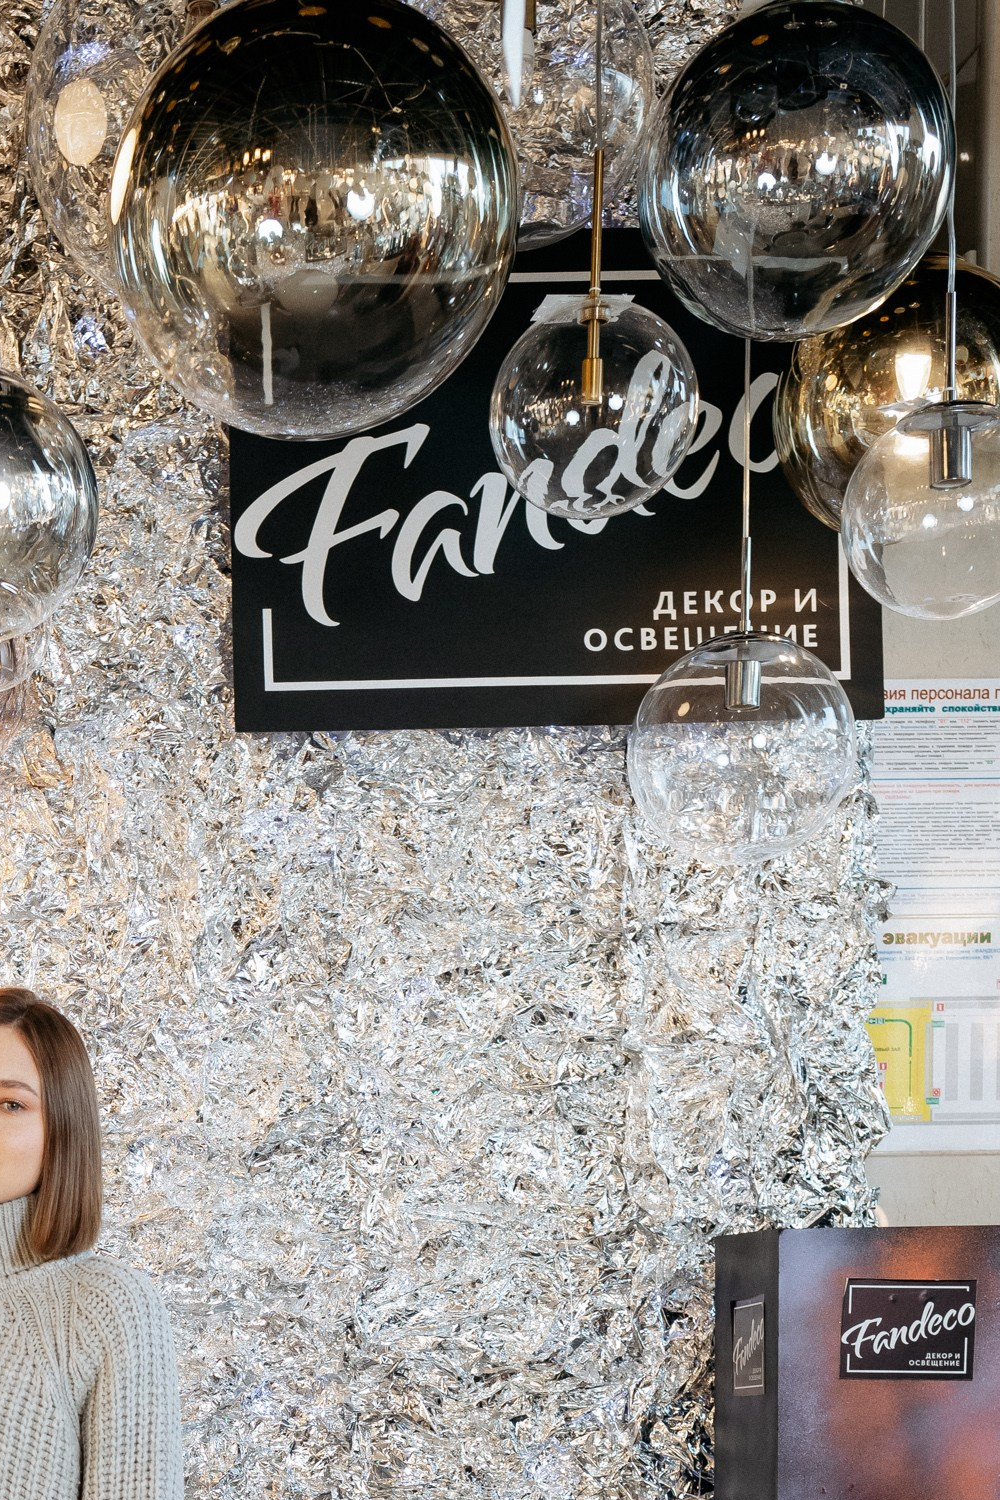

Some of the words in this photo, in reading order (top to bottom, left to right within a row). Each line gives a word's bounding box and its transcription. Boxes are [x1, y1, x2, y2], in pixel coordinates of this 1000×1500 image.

[234, 349, 779, 627] Fandec
[653, 589, 777, 621] ДЕКОР
[794, 588, 818, 613] И
[583, 623, 819, 652] ОСВЕЩИЕ
[911, 688, 990, 703] персонала
[885, 704, 936, 714] храняйте
[882, 931, 992, 949] эвакуации
[841, 1301, 976, 1359] Fandeco
[908, 1359, 961, 1367] ОСВЕЩЕНИЕ
[925, 1352, 953, 1360] ДЕКОР
[954, 1352, 961, 1360] И
